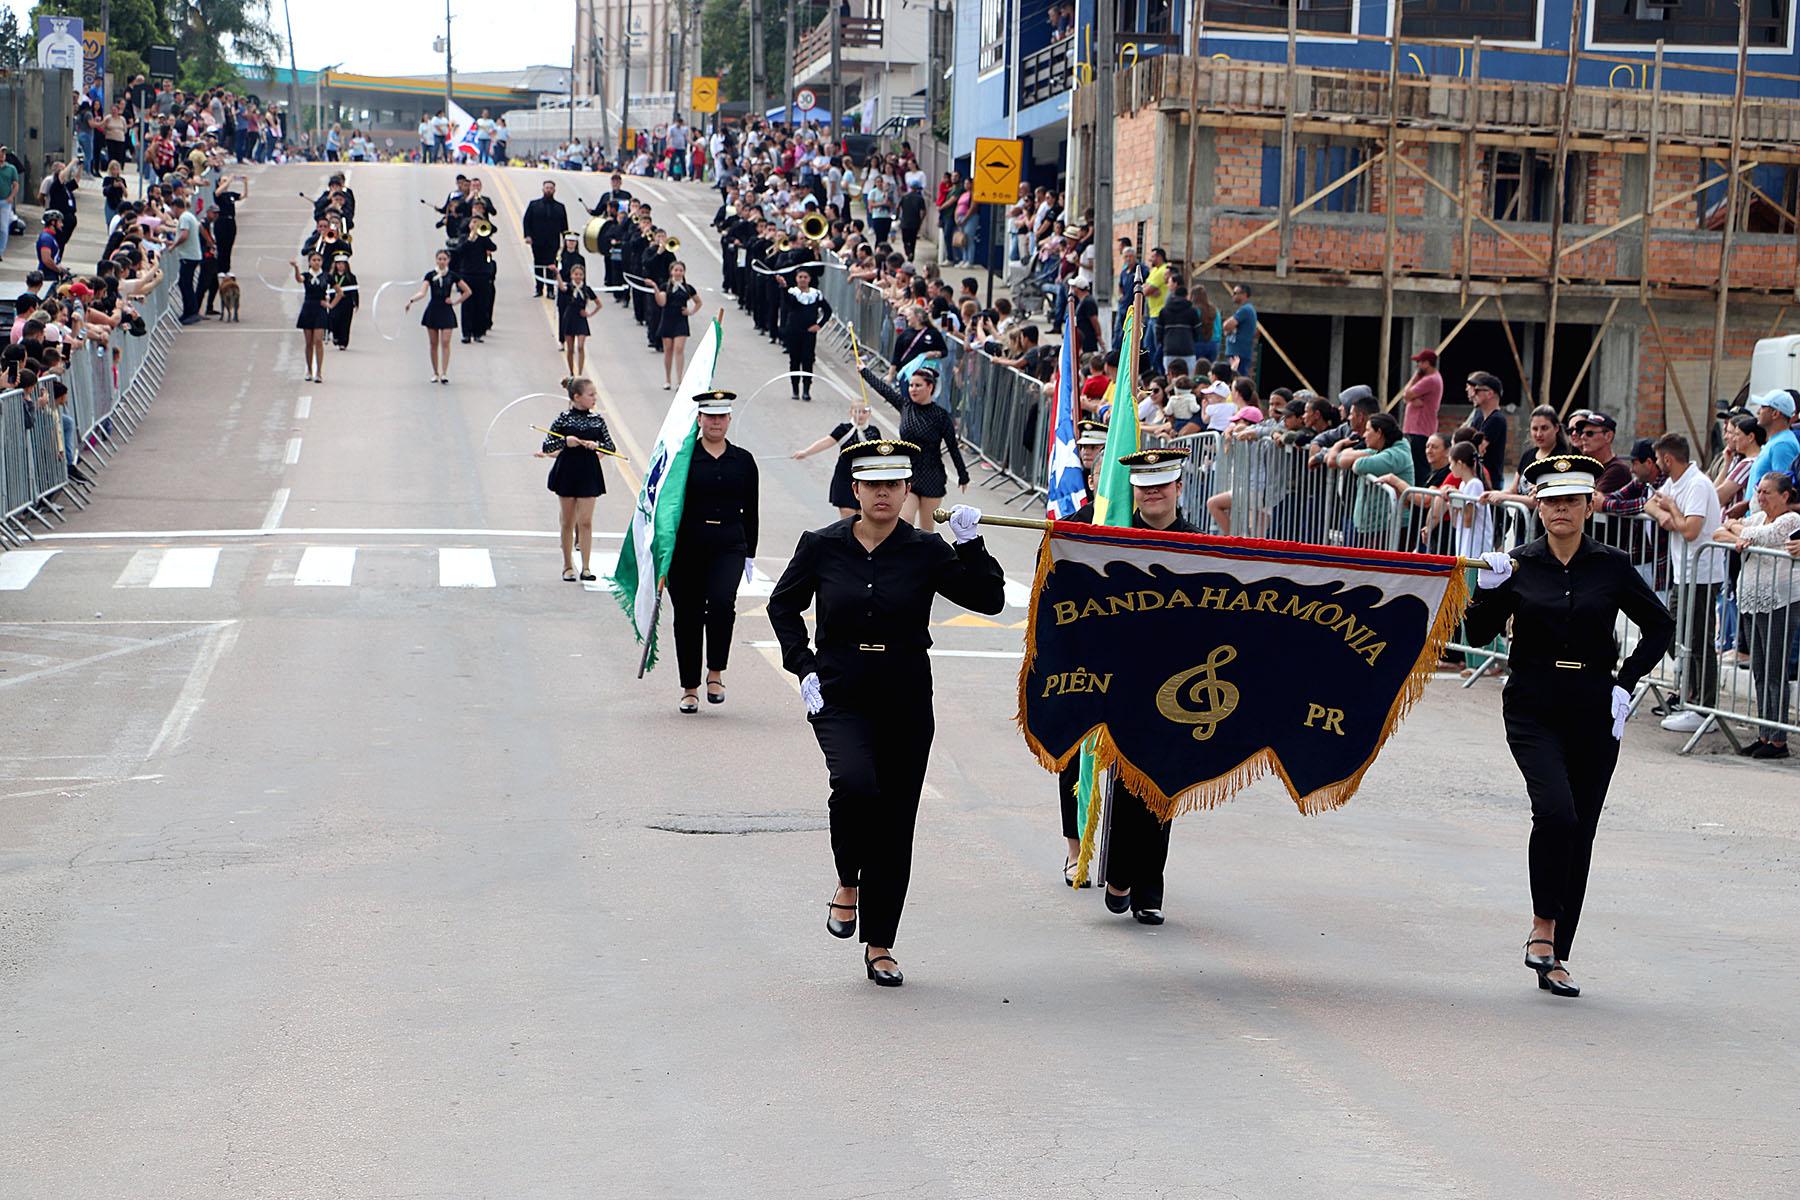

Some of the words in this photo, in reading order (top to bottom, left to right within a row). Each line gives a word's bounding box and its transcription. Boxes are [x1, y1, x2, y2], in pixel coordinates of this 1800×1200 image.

[800, 93, 813, 104] 30
[1053, 589, 1193, 625] BANDA
[1197, 587, 1387, 666] HARMONIA
[1042, 667, 1113, 698] PIÊN
[1303, 703, 1345, 736] PR
